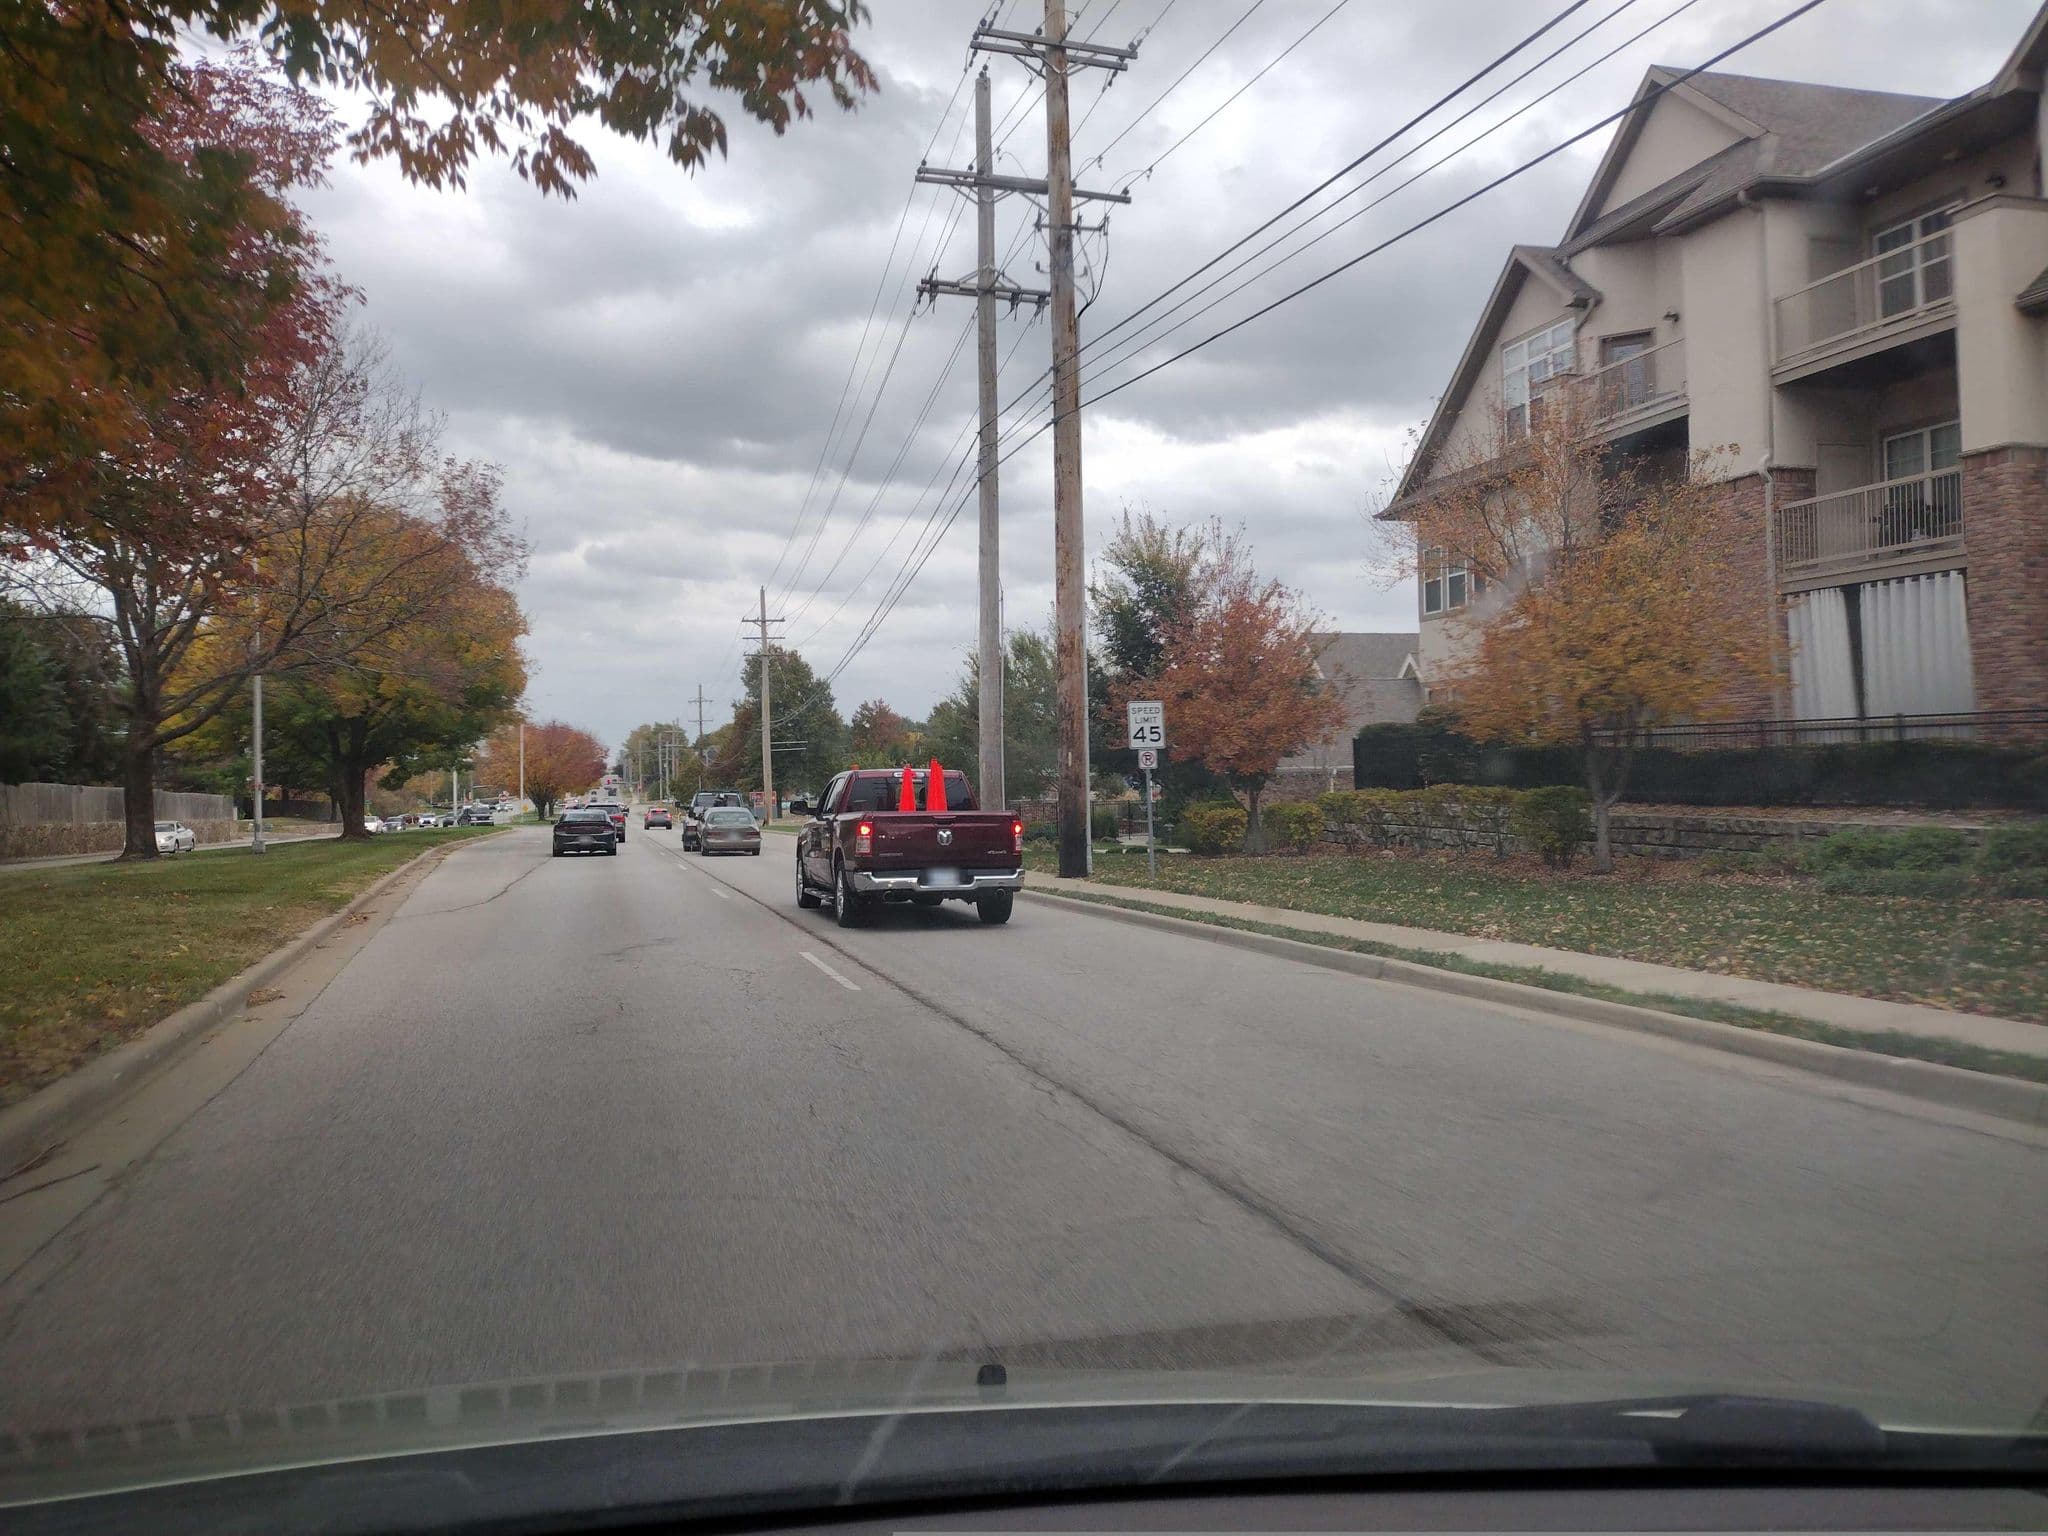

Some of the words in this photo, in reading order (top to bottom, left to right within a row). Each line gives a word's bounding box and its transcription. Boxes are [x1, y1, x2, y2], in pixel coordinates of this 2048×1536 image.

[1131, 707, 1160, 715] SPEED
[1135, 716, 1158, 724] LIMIT
[1133, 726, 1161, 743] 45
